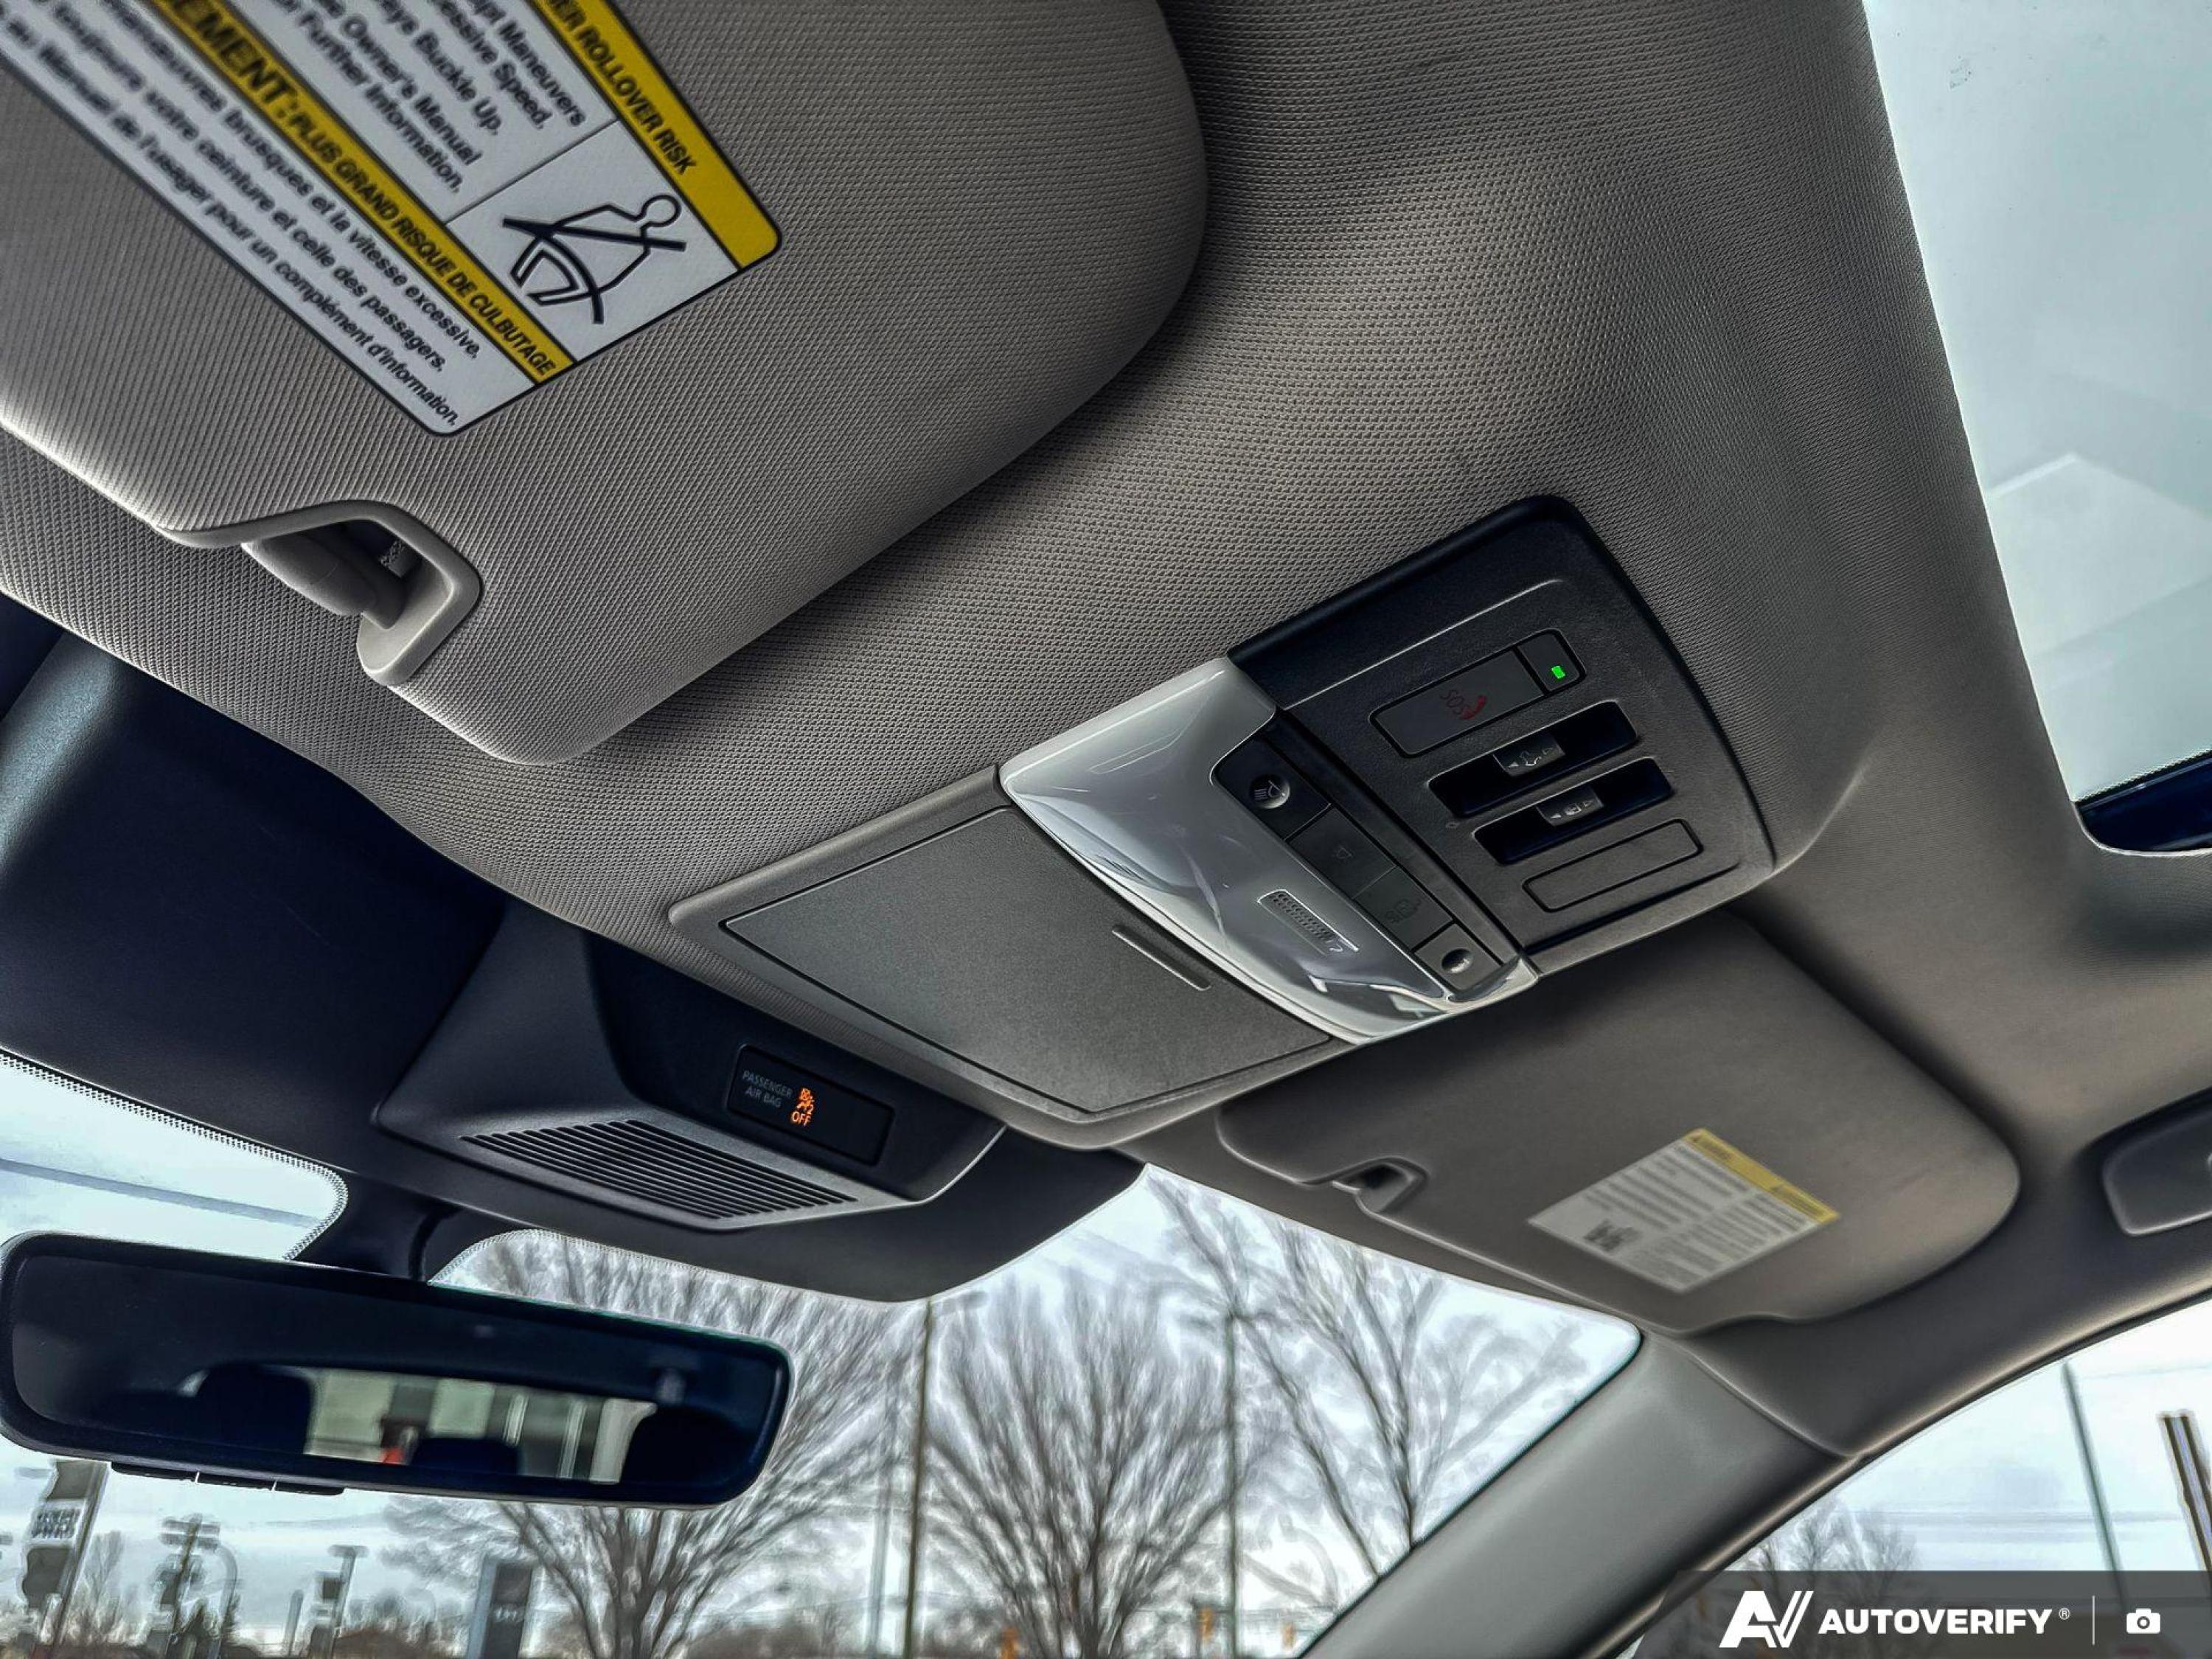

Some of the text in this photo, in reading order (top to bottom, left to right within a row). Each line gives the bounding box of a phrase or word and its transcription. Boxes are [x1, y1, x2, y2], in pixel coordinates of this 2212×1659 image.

[412, 30, 477, 102] Buckle
[497, 20, 586, 127] Maneuvers
[576, 25, 664, 133] ROLLOVER
[653, 129, 698, 175] RISK
[414, 94, 482, 166] Manual
[197, 139, 276, 212] ceinture
[272, 209, 297, 232] et
[291, 228, 335, 268] celle
[333, 265, 368, 297] des
[224, 110, 313, 196] brusques
[310, 195, 335, 215] et
[329, 209, 351, 233] la
[348, 228, 408, 286] vitesse
[288, 112, 343, 164] PLUS
[334, 158, 400, 220] GRAND
[393, 215, 456, 276] RISQUE
[445, 270, 478, 299] DE
[469, 296, 557, 376] CULBUTAGE
[204, 201, 256, 241] pour
[250, 237, 278, 264] un
[274, 261, 374, 347] complément
[742, 1070, 793, 1099] PASSENGER
[745, 1085, 782, 1108] AIR BAG
[791, 1110, 812, 1127] OFF
